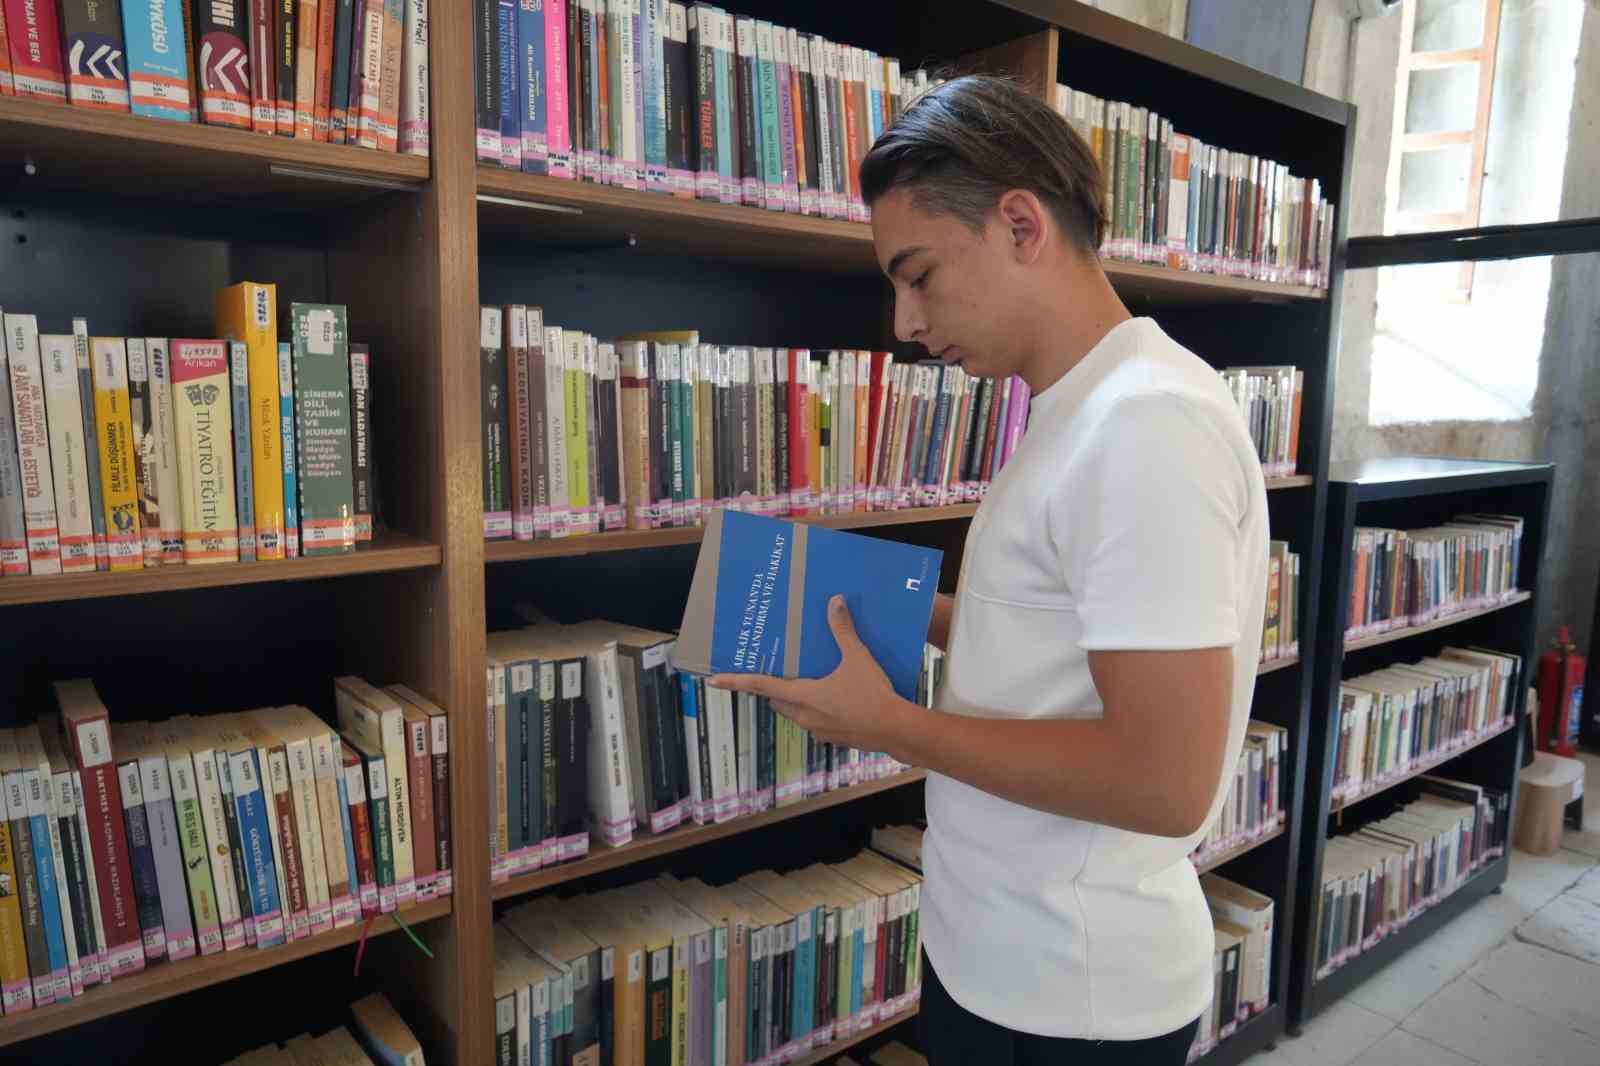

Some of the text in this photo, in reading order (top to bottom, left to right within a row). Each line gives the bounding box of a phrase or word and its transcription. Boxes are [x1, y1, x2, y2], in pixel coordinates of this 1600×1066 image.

[303, 388, 344, 399] SİNEMA
[196, 408, 213, 475] TİYATRO
[304, 419, 318, 427] VE
[745, 599, 772, 671] ADLANDIRMA
[761, 581, 775, 597] VE
